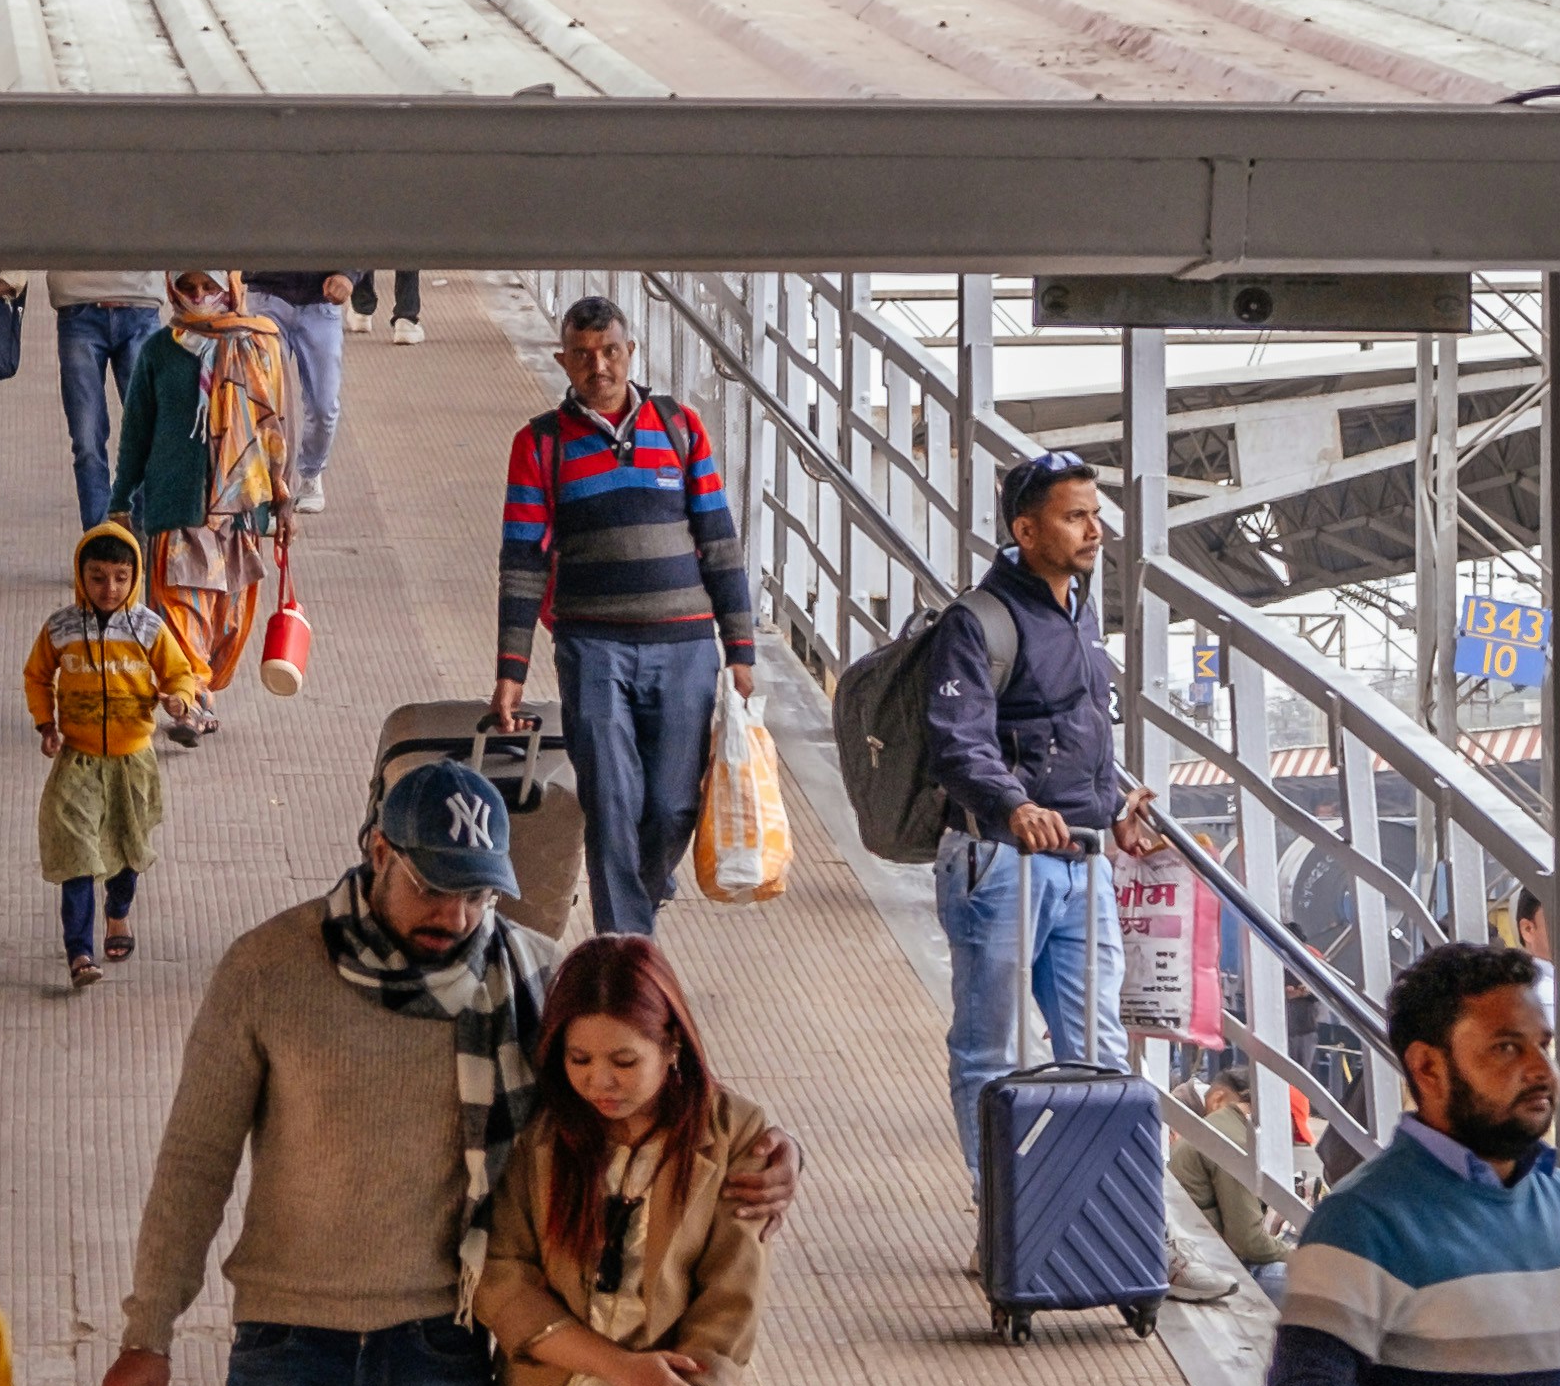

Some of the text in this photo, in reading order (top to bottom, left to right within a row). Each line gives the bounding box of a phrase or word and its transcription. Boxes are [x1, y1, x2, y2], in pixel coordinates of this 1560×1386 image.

[1466, 599, 1545, 643] 1343
[1483, 641, 1517, 678] 10
[445, 792, 494, 851] NY
